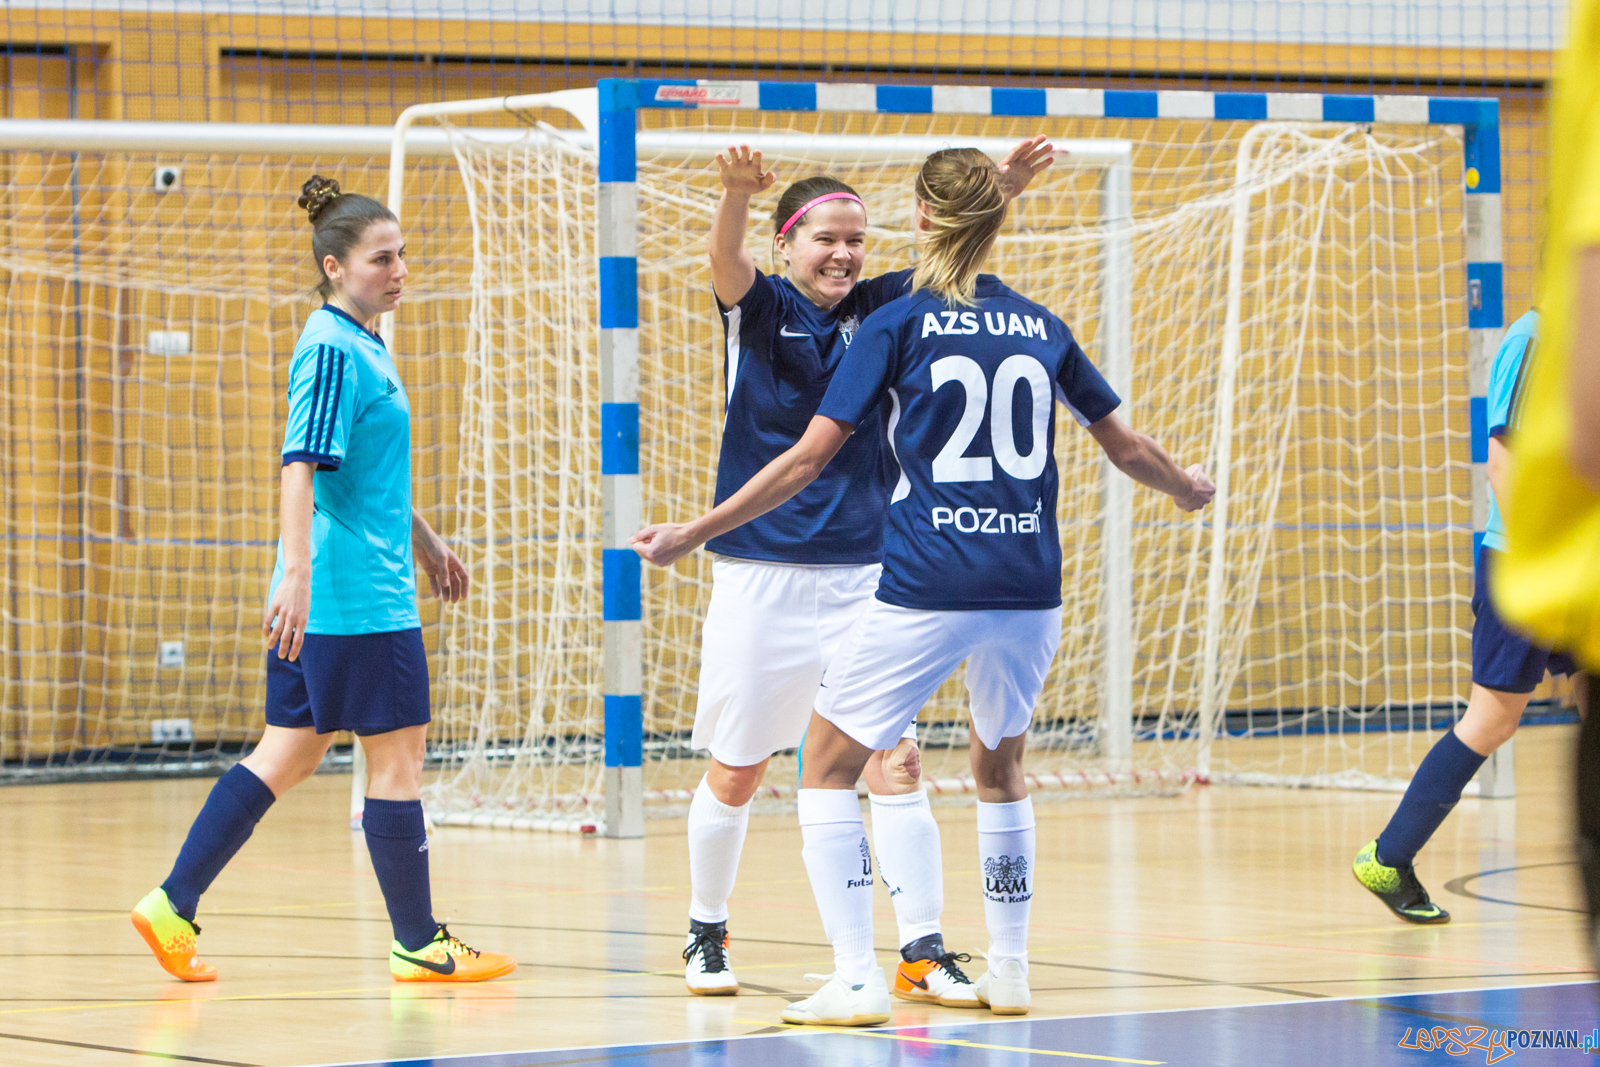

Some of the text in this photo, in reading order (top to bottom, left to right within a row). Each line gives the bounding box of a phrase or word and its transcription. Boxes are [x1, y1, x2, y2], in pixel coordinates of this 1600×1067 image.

[921, 311, 1047, 340] AZS UAM
[930, 354, 1051, 483] 20
[986, 877, 1027, 894] UAM
